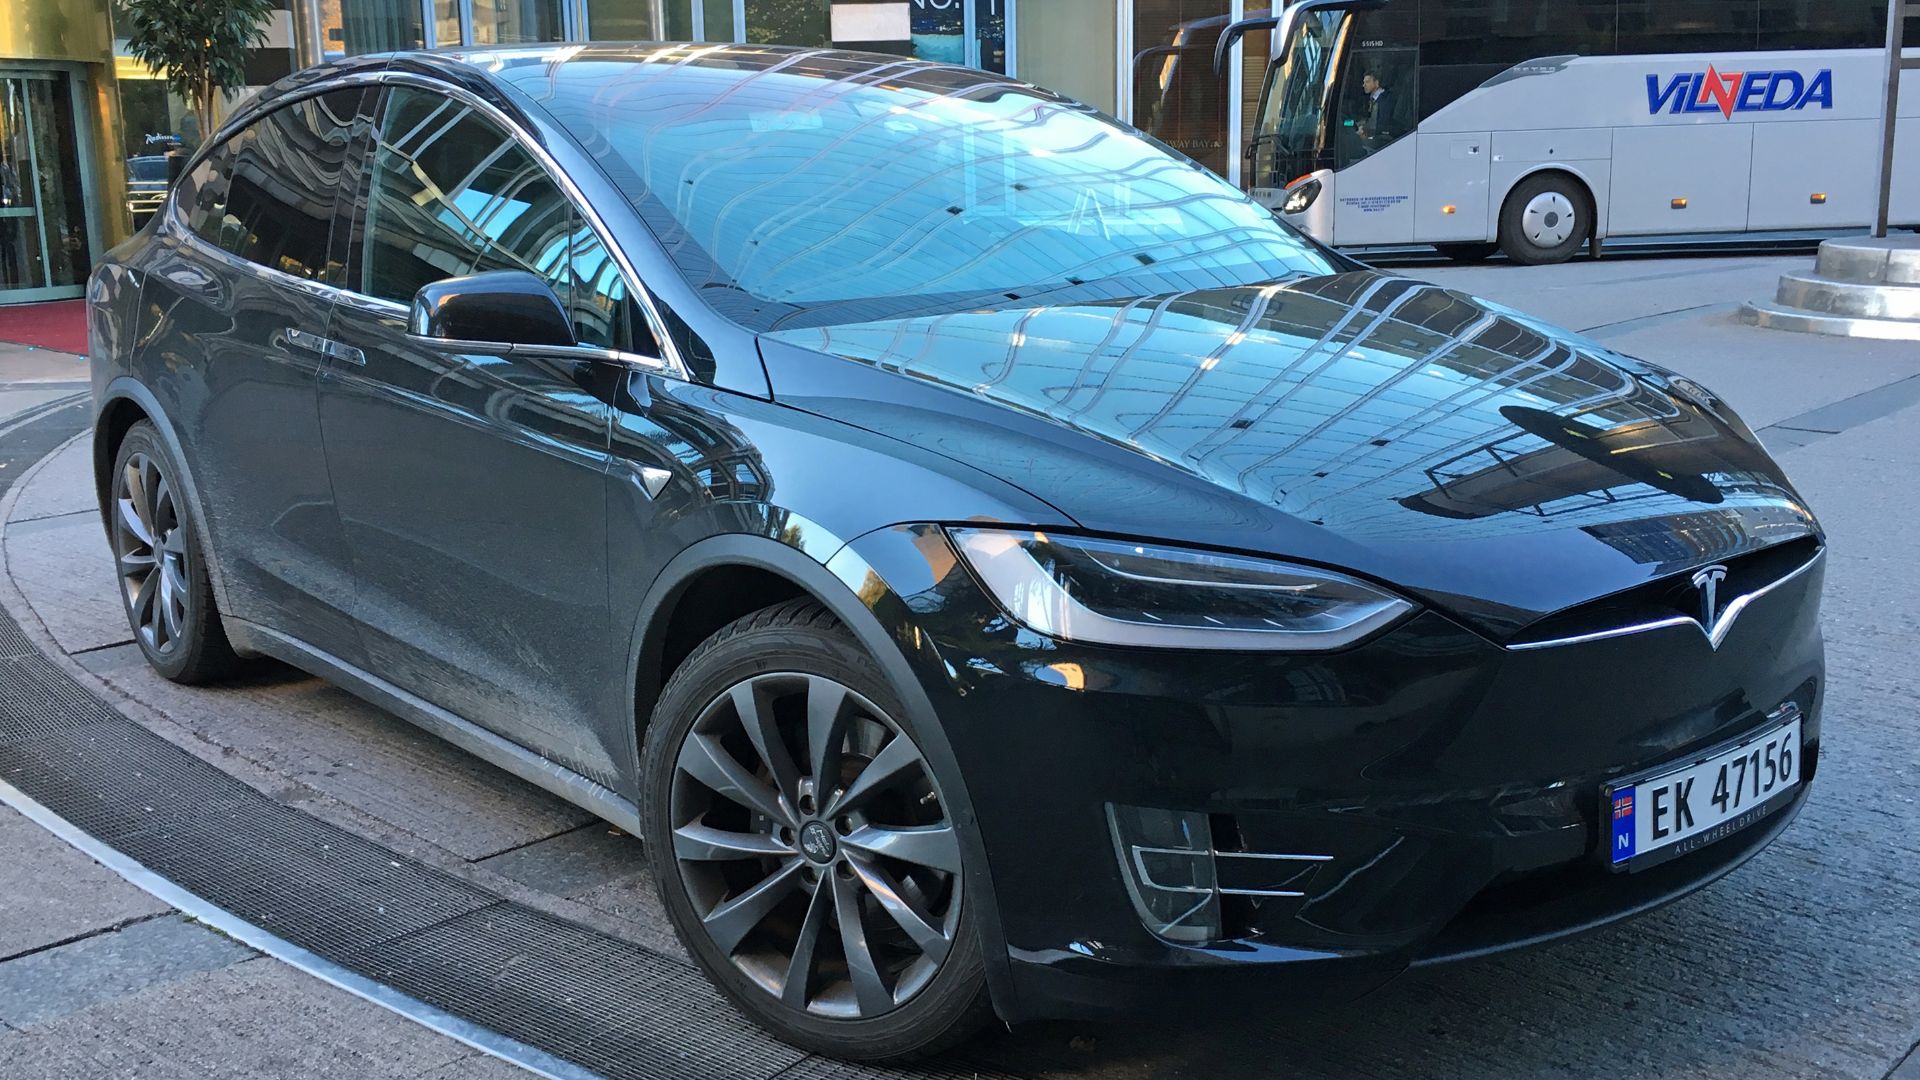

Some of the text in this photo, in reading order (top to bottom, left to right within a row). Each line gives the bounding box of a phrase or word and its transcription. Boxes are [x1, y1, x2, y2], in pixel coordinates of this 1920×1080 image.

[1652, 731, 1792, 840] EK 47156
[1740, 805, 1767, 827] DRIVE
[1618, 833, 1629, 850] N
